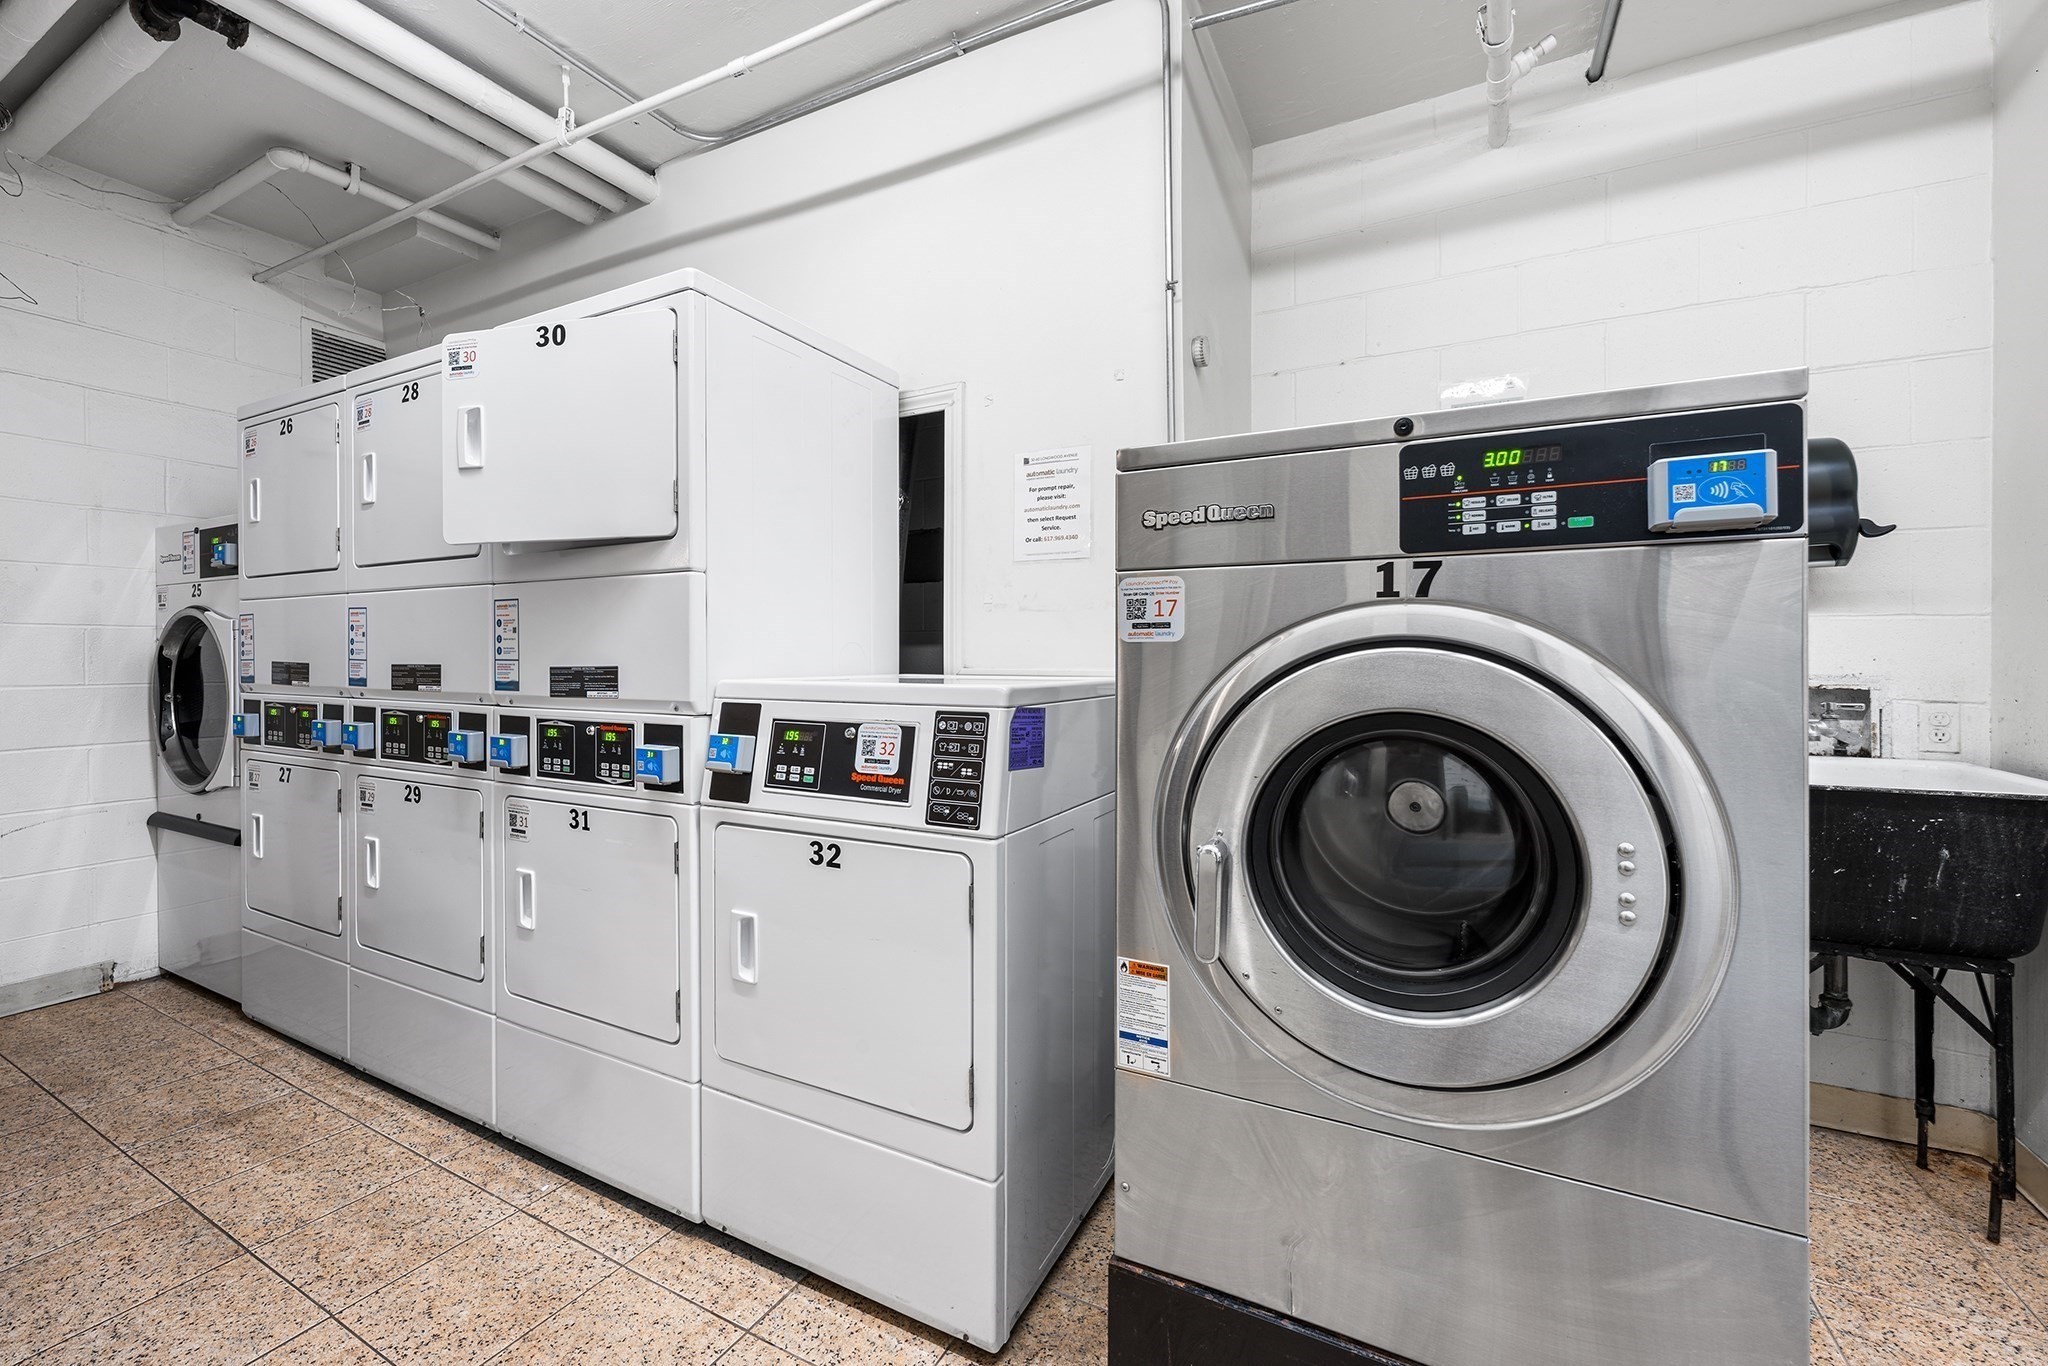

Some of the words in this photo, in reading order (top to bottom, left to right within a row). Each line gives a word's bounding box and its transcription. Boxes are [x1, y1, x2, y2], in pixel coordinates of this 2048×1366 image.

[535, 324, 566, 348] 30
[463, 350, 477, 363] 30
[402, 382, 419, 403] 28
[280, 418, 293, 436] 26
[1026, 469, 1055, 478] automatic
[1056, 466, 1079, 475] laundry
[1037, 484, 1057, 494] prompt
[1057, 483, 1075, 492] repair,
[1024, 503, 1081, 513] automaticlaundry.com
[1142, 506, 1206, 531] Speed
[1206, 503, 1275, 522] Queen
[1376, 560, 1443, 598] 17
[191, 584, 202, 598] 25
[1154, 599, 1178, 617] 17
[879, 741, 896, 756] 32
[279, 767, 292, 783] 27
[851, 772, 878, 783] Speed
[878, 775, 905, 785] Queen
[367, 791, 375, 802] 29
[404, 784, 421, 804] 29
[860, 783, 888, 793] Commercial
[888, 786, 903, 795] Dryer
[519, 816, 528, 828] 31
[569, 808, 590, 831] 31
[809, 840, 841, 869] 32
[1137, 963, 1165, 973] WARNING
